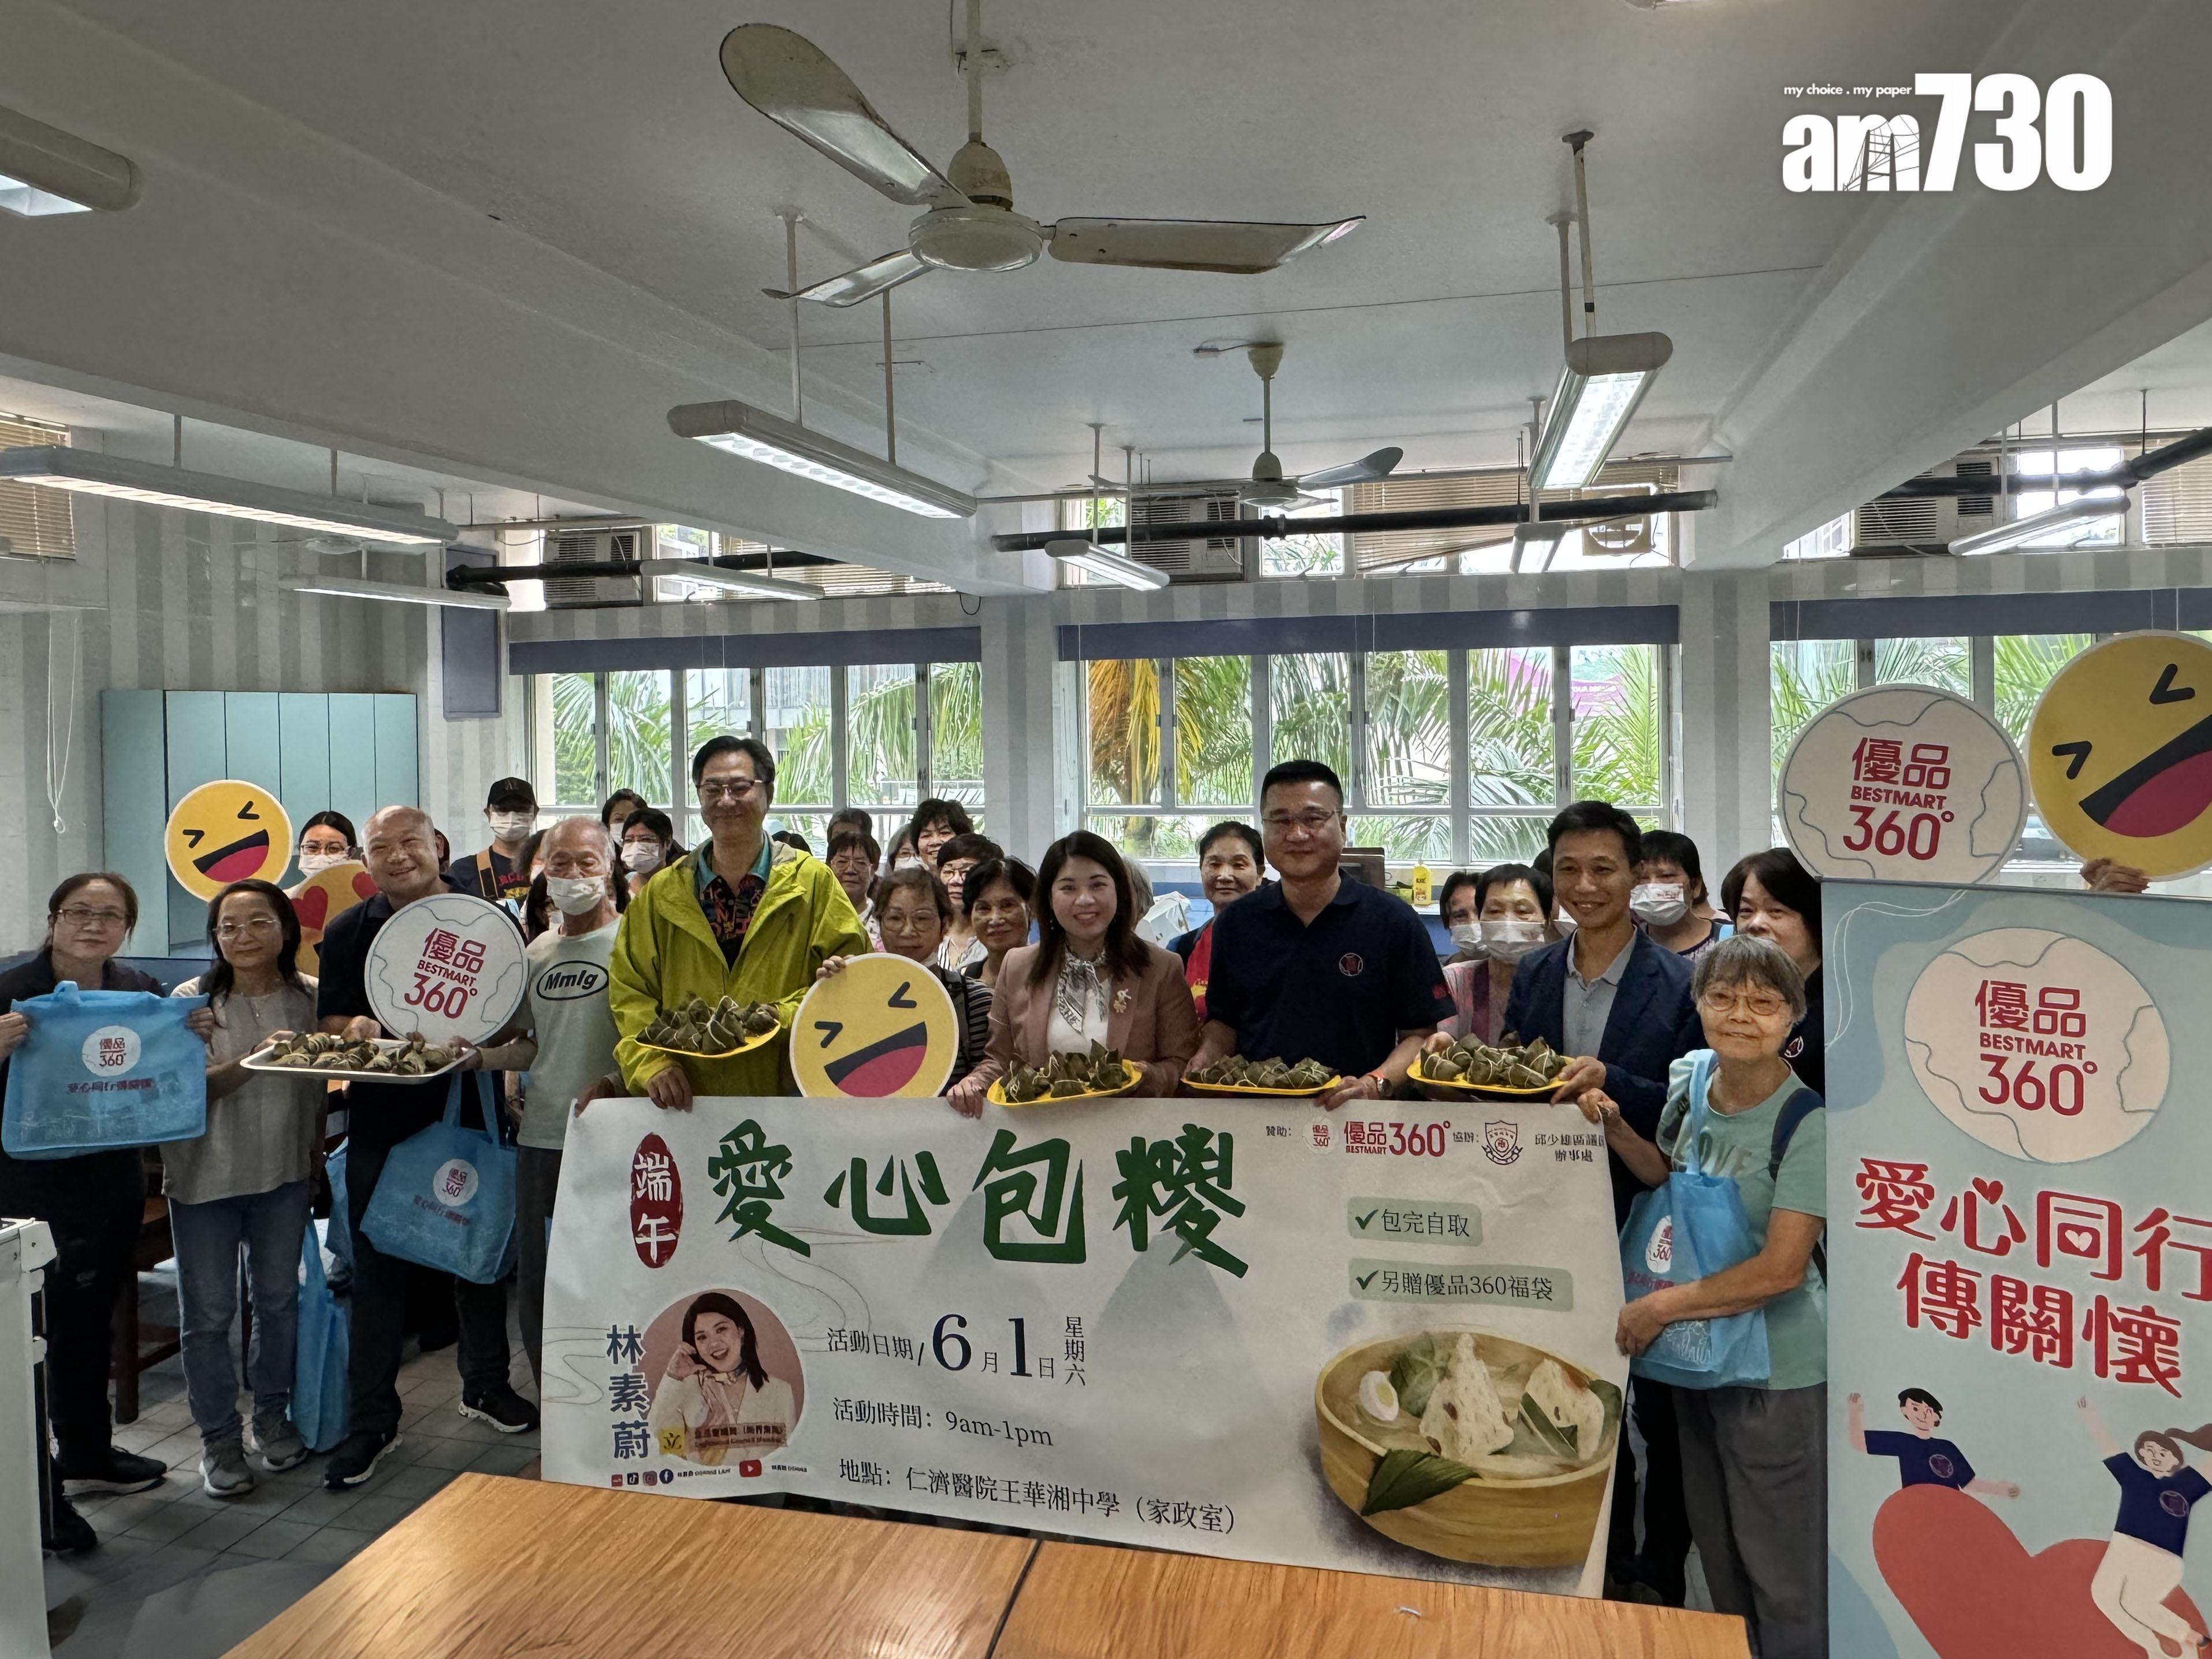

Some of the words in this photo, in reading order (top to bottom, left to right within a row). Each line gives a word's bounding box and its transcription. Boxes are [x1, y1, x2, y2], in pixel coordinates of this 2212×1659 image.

[1852, 737, 1950, 789] 優品
[1851, 785, 1947, 810] BESTMART
[417, 959, 477, 988] BESTMART
[422, 927, 486, 974] 優品
[1975, 979, 2086, 1038] 優品
[1980, 1032, 2086, 1060] BESTMART
[1344, 1121, 1386, 1145] 優品
[1345, 1145, 1387, 1155] BESTMART
[634, 1153, 676, 1263] 端午
[1381, 1209, 1470, 1237] 包完自取
[1856, 1157, 2212, 1301] 愛心同行
[1381, 1271, 1553, 1301] 另贈優品360福袋
[1897, 1252, 2183, 1398] 傳關懷
[1064, 1315, 1085, 1386] 星期六
[607, 1324, 650, 1459] 林素蔚
